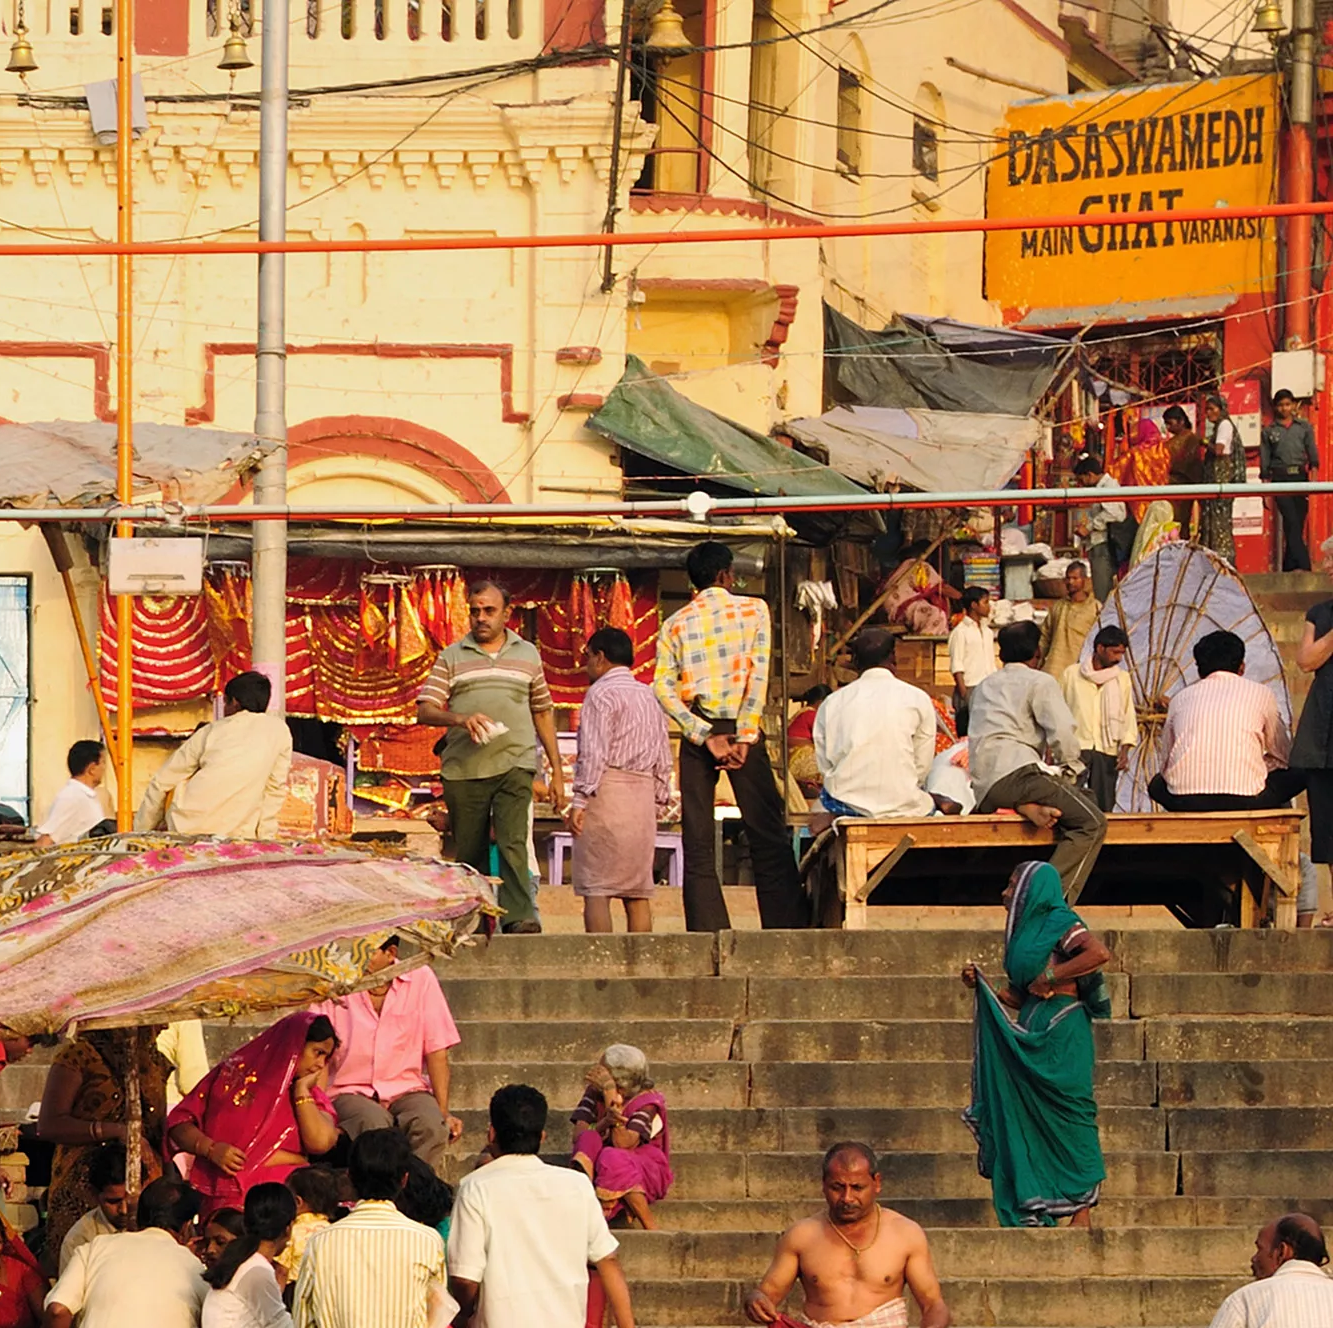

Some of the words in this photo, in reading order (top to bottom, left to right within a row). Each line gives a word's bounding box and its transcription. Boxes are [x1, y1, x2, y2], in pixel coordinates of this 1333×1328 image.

[1008, 105, 1264, 187] DASASWAMEDH
[1020, 225, 1073, 258] MAIN
[1078, 188, 1183, 253] GHAT
[1180, 217, 1263, 246] VARANASI
